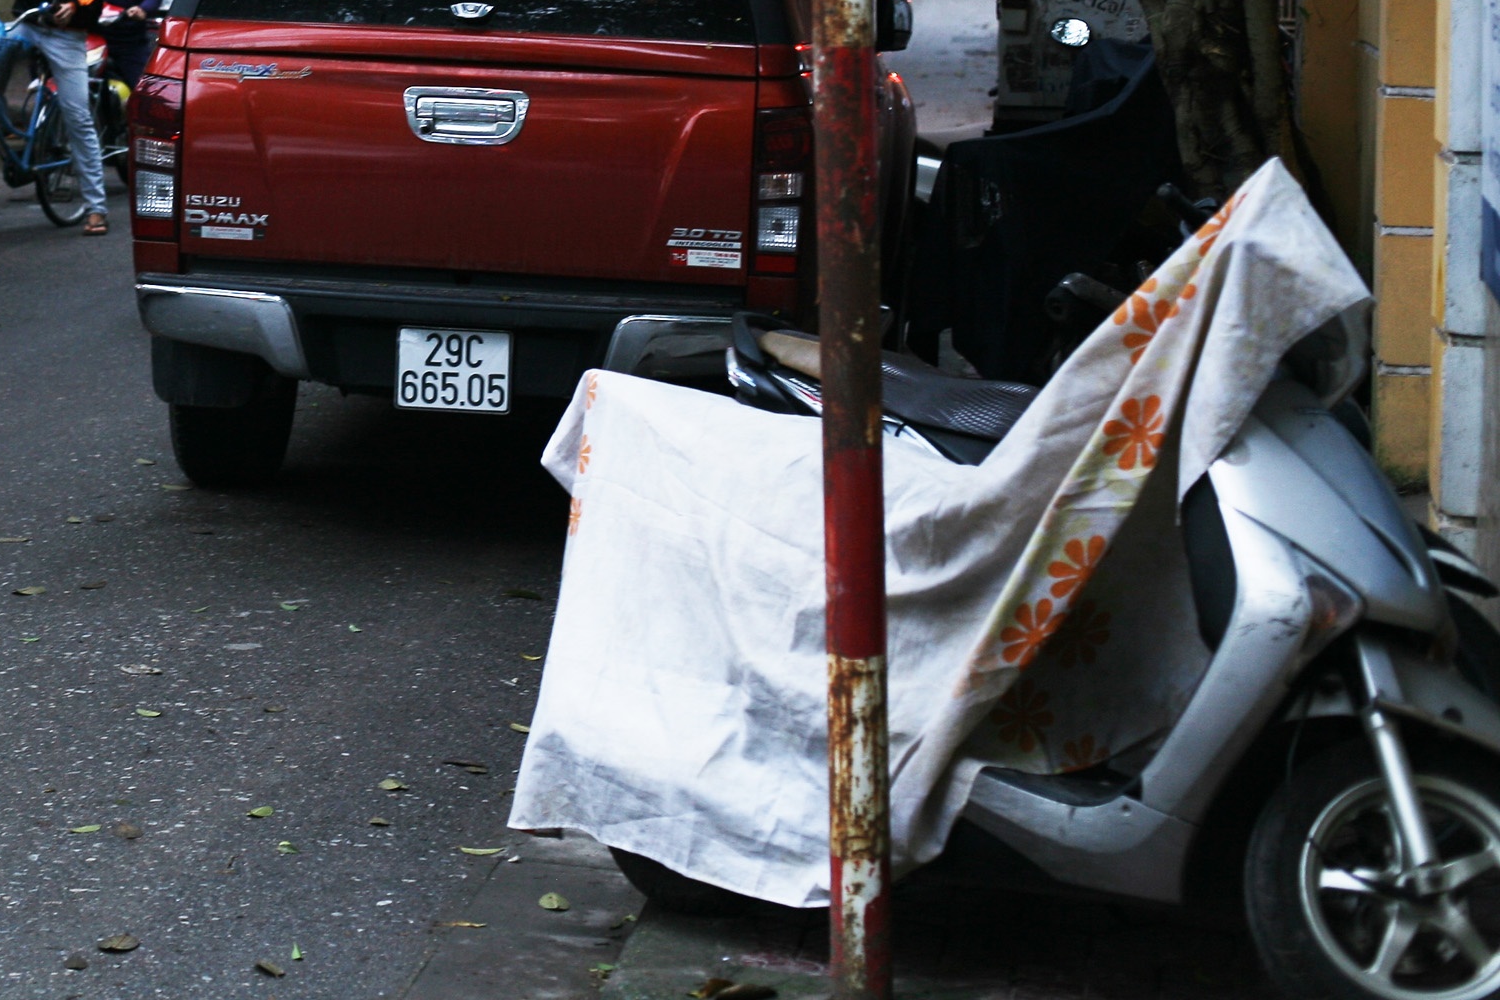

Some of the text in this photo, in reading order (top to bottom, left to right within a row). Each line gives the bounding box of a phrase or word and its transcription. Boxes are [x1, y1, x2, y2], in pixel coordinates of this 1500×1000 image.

[185, 194, 241, 207] ISUZU
[424, 332, 484, 369] 29C
[400, 369, 507, 408] 665.05
